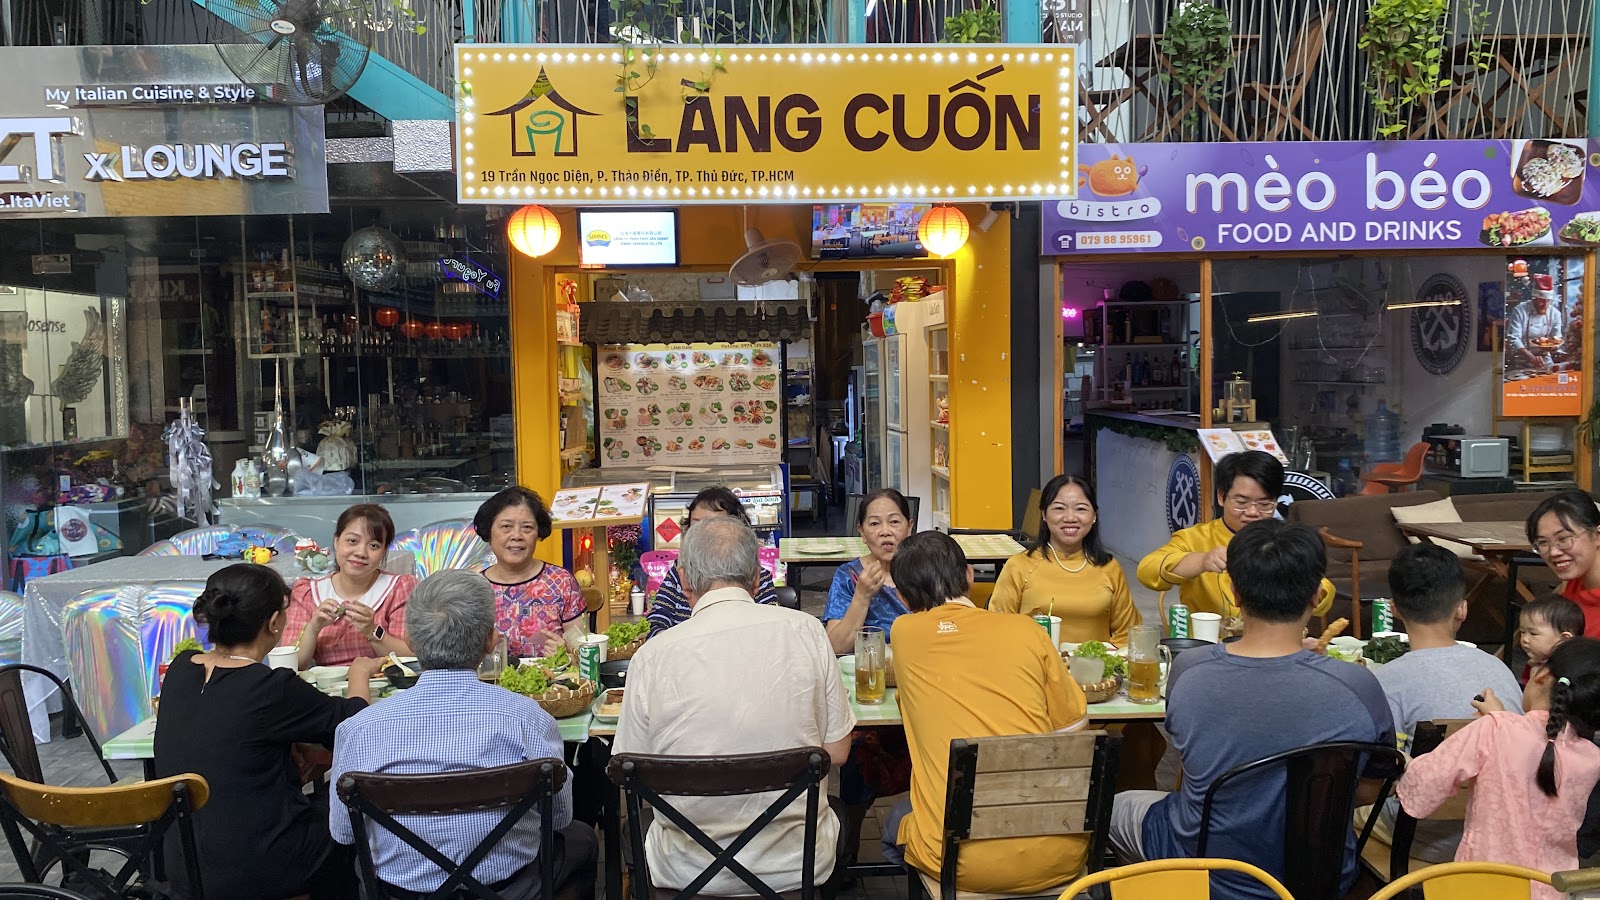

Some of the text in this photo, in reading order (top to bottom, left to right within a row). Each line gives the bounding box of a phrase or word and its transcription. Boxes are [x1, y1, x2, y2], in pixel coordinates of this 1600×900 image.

[45, 85, 256, 104] My Italian Cuisine & Style
[625, 64, 1041, 153] LÀNG CUỐN
[121, 142, 291, 180] LOUNGE
[481, 168, 794, 185] 19 Trần Ngọc Diện, P. Thảo Điền, TP. Thủ Đức, TP.HCM
[1185, 152, 1492, 213] mèo béo
[1069, 202, 1150, 218] bistro
[1080, 234, 1152, 245] 079 88 95961
[1217, 219, 1462, 244] FOOD AND DRINKS
